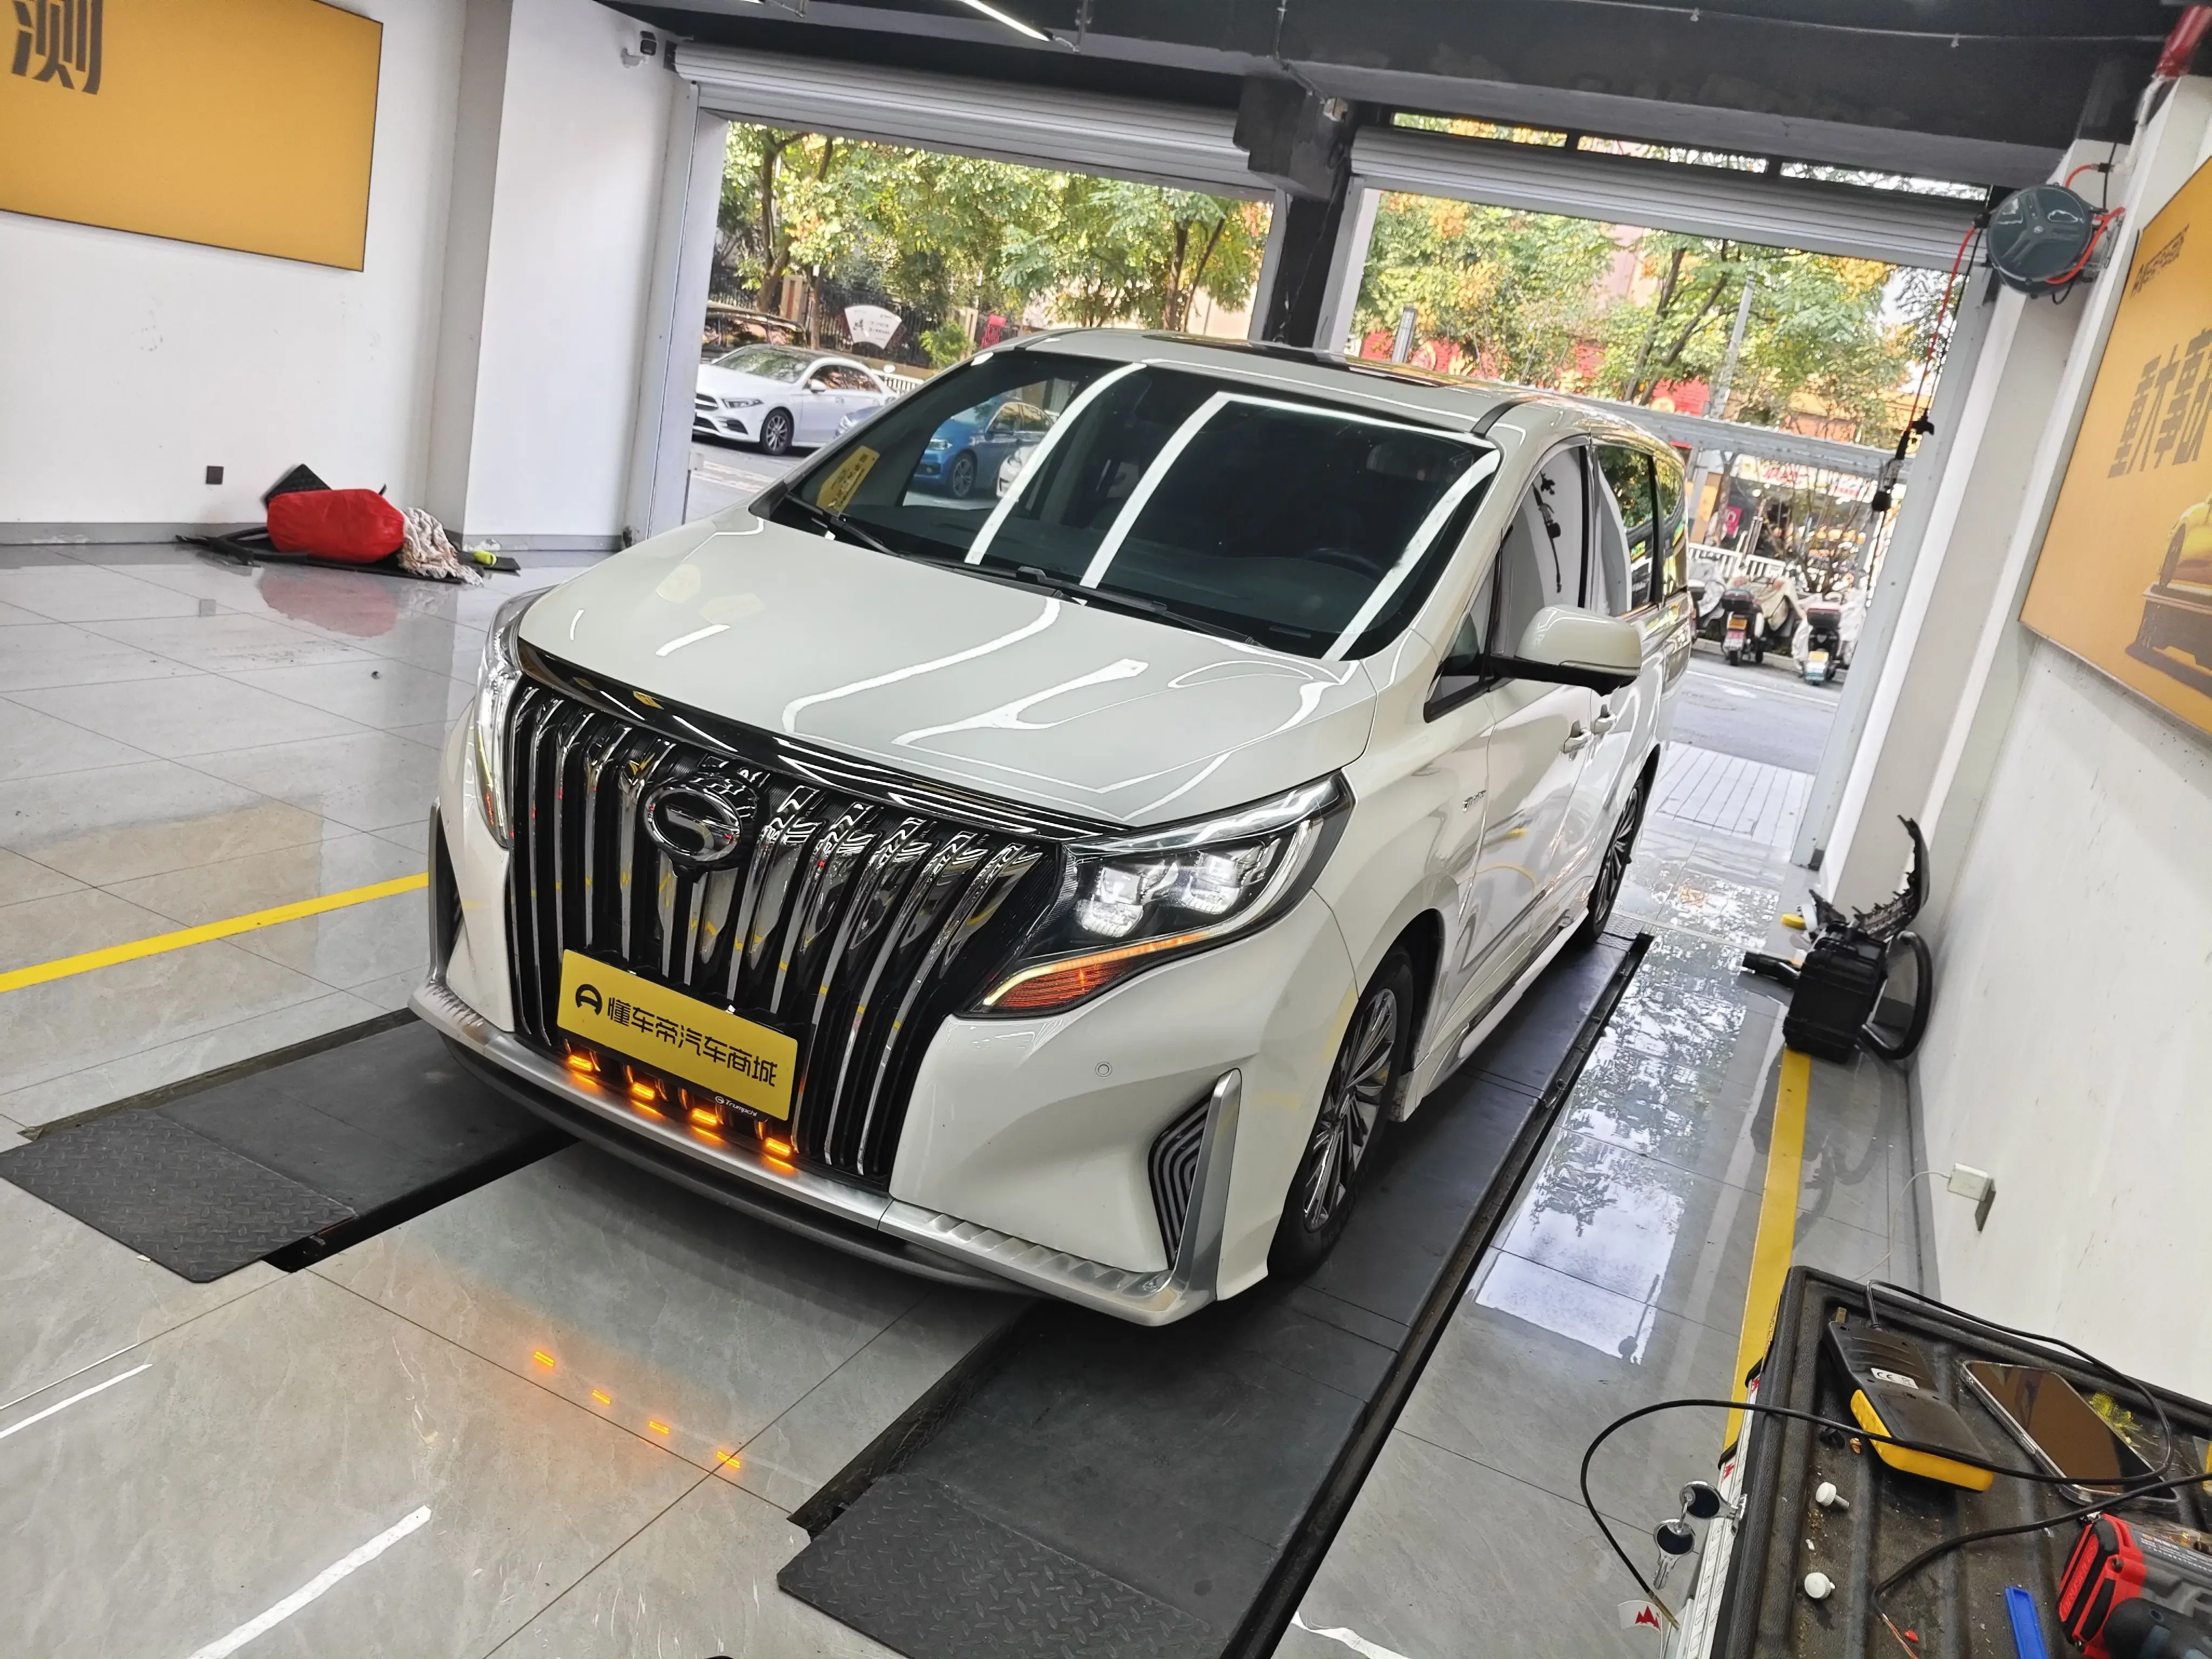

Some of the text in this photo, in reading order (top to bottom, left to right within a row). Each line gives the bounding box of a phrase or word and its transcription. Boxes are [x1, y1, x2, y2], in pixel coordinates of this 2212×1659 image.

[11, 0, 103, 95] 测
[607, 996, 778, 1087] 懂车帝汽车商城
[725, 1099, 757, 1116] Trumpchi
